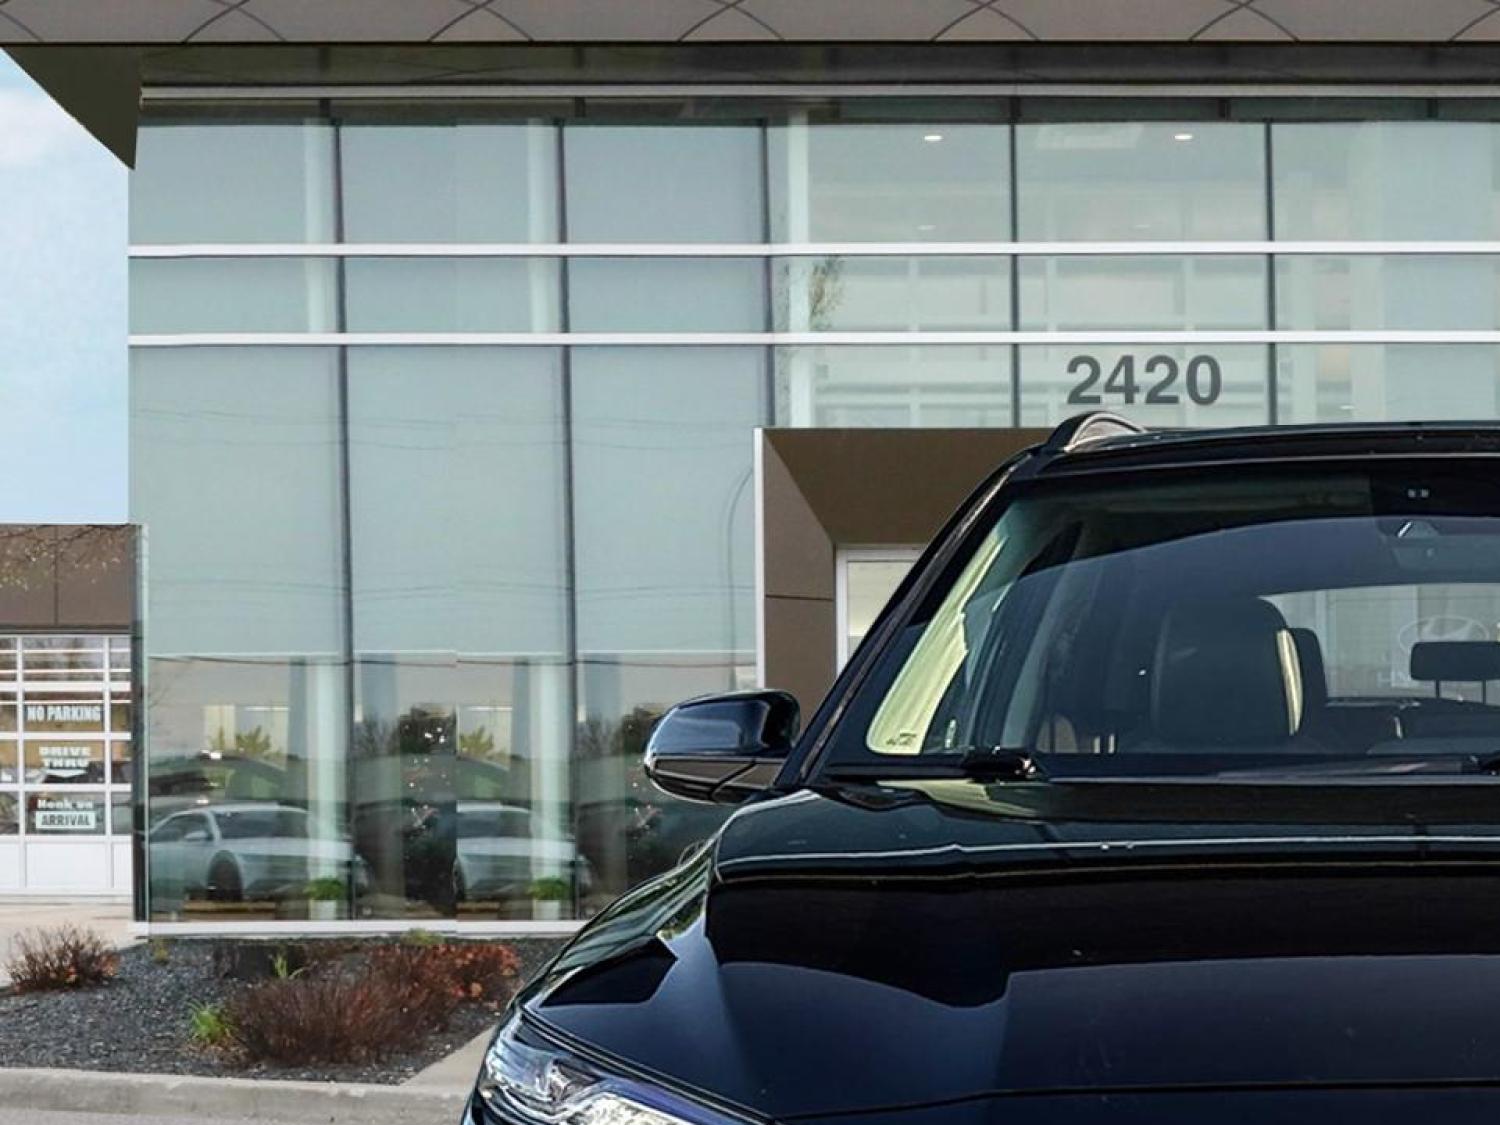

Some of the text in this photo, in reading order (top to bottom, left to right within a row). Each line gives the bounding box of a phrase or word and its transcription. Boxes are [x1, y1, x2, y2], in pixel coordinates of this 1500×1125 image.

[1066, 354, 1222, 406] 2420
[27, 705, 101, 722] NO PARKING
[41, 813, 91, 827] ARRIVAL
